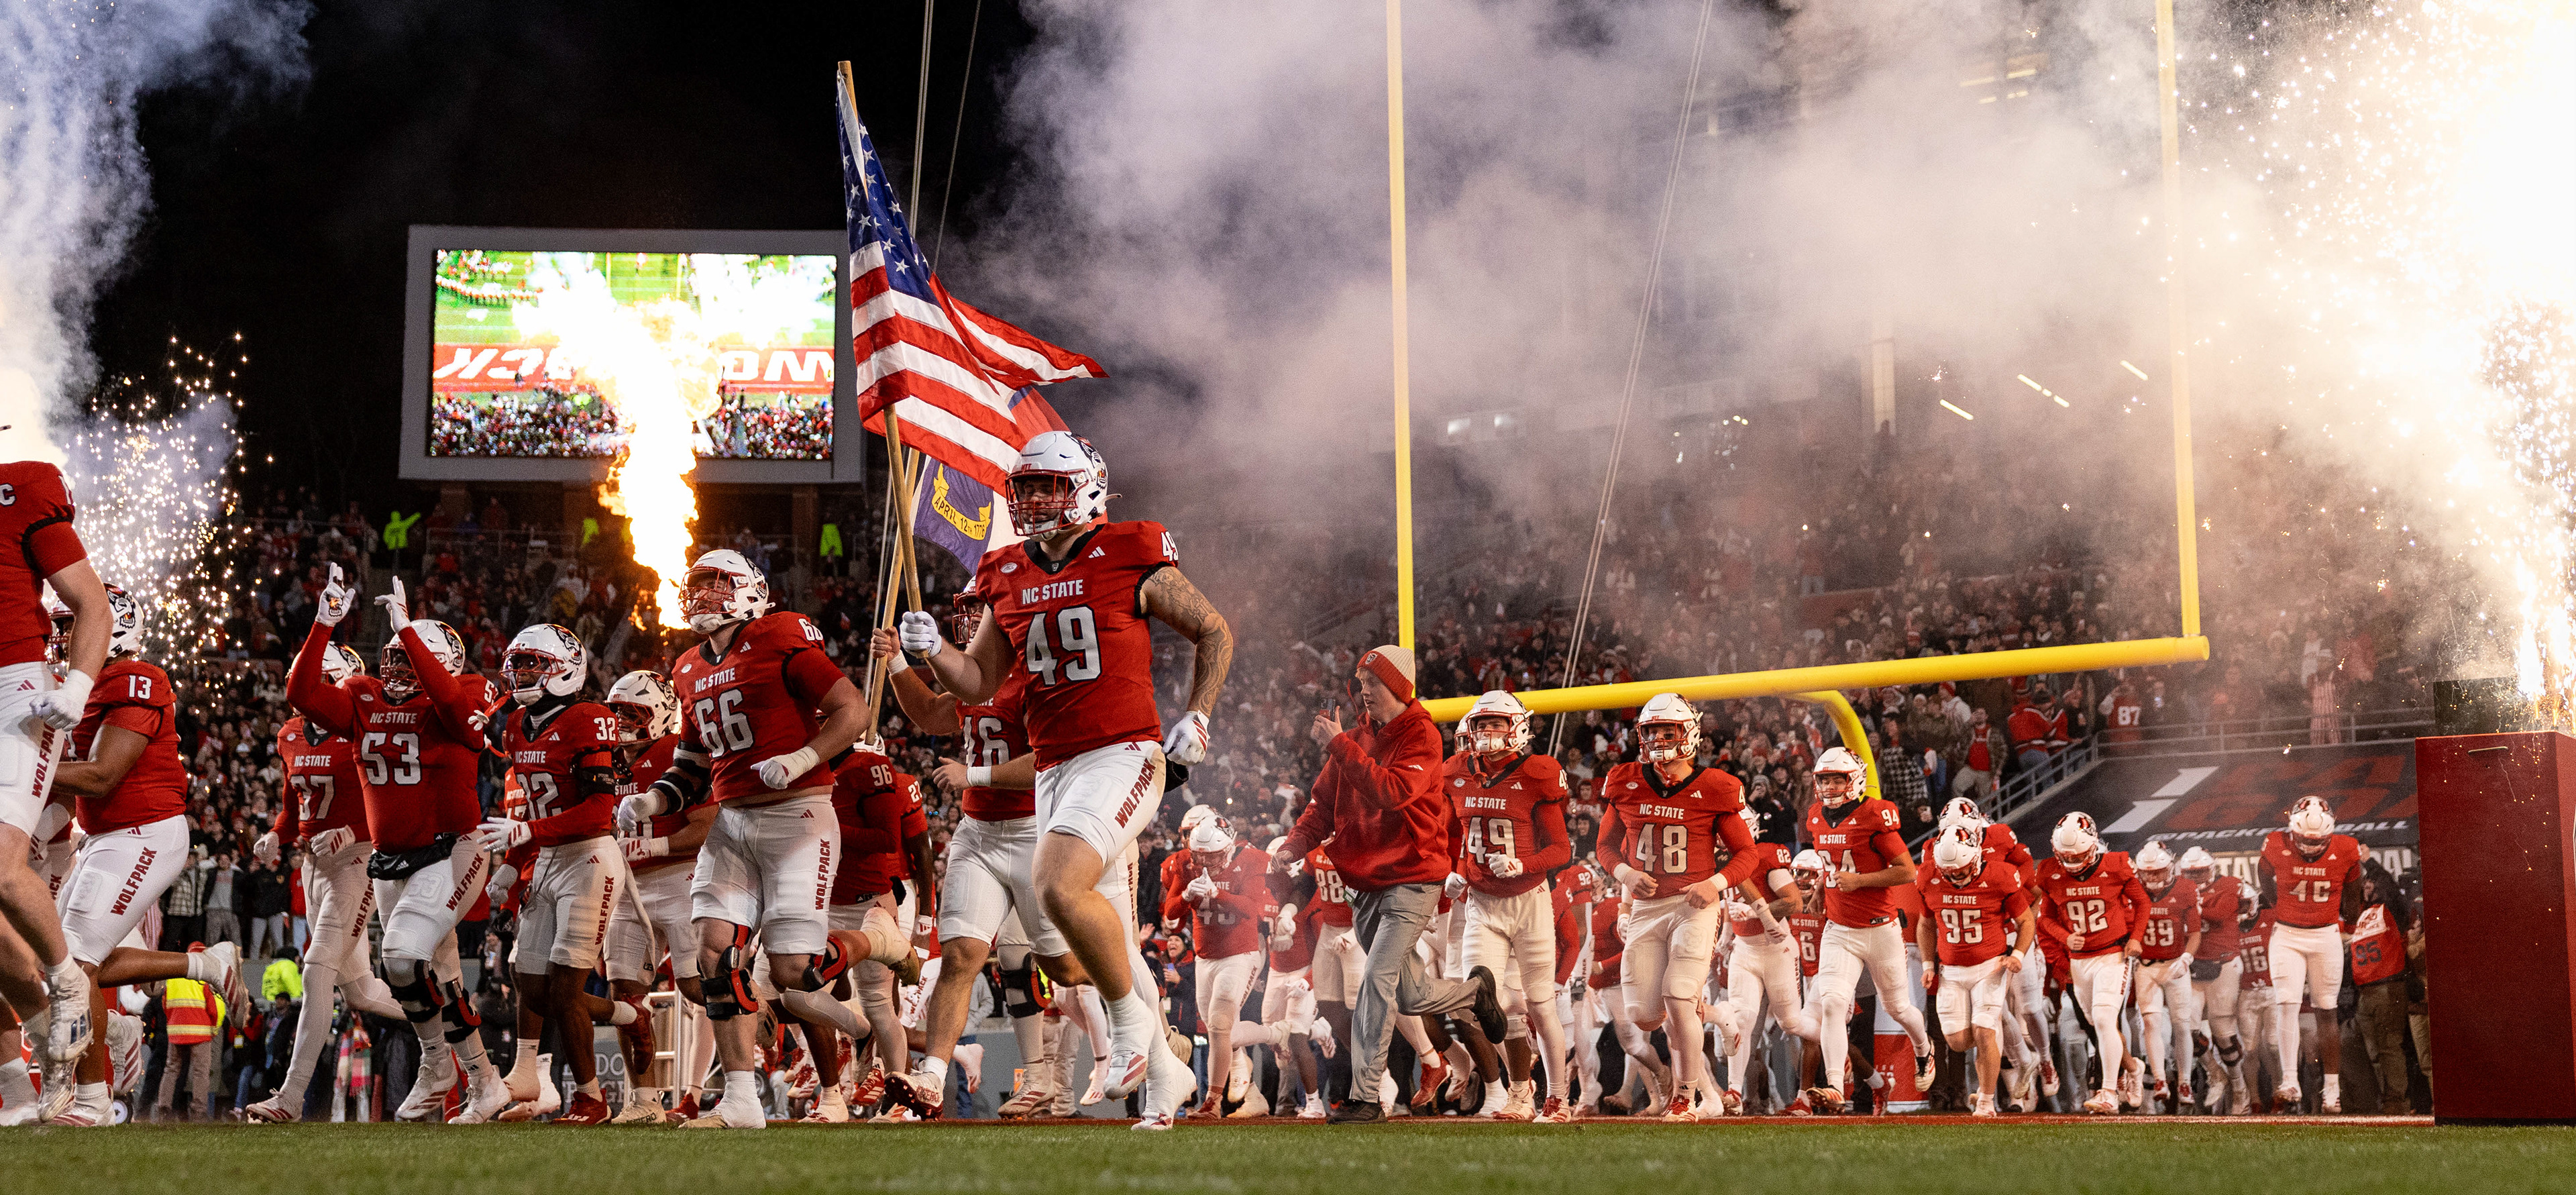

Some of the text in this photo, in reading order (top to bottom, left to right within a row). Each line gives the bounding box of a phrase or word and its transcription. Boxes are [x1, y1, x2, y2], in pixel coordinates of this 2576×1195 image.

[934, 496, 957, 525] APRIL
[973, 524, 985, 537] 1776
[1161, 530, 1179, 562] 49
[1022, 579, 1084, 605] NC STATE
[798, 617, 824, 641] 66
[1025, 604, 1102, 687] 49
[128, 674, 152, 700] 13
[695, 667, 736, 693] NC STATE
[370, 712, 418, 724] NC STATE
[694, 688, 755, 759] 66
[2117, 705, 2142, 726] 87
[594, 717, 616, 741] 32
[32, 721, 56, 799] WOLFPA
[294, 755, 332, 767] NC STATE
[361, 731, 422, 786] 53
[515, 751, 547, 764] NC STATE
[615, 782, 639, 795] STATE
[870, 764, 893, 787] 96
[289, 774, 335, 821] 37
[1114, 758, 1157, 830] WOLFPACK
[1464, 796, 1507, 810] NC STATE
[1640, 804, 1685, 820] NC STATE
[1881, 809, 1900, 827] 94
[1467, 816, 1517, 864] 49
[1635, 823, 1688, 874] 48
[1819, 834, 1846, 845] NC STATE
[1776, 848, 1792, 864] 82
[110, 846, 158, 916] WOLFPACK
[445, 853, 484, 912] WOLFPACK
[815, 838, 830, 911] WOLFPACK
[1577, 872, 1592, 886] 92
[2292, 866, 2326, 877] NC STATE
[1943, 894, 1977, 905] NC STATE
[2066, 886, 2100, 896] NC STATE
[594, 875, 614, 945] WOLFPACK
[1791, 918, 1819, 928] NC STATE
[2065, 898, 2109, 934] 92
[1940, 908, 1984, 945] 95
[1799, 931, 1817, 962] 6
[2355, 940, 2382, 967] 95
